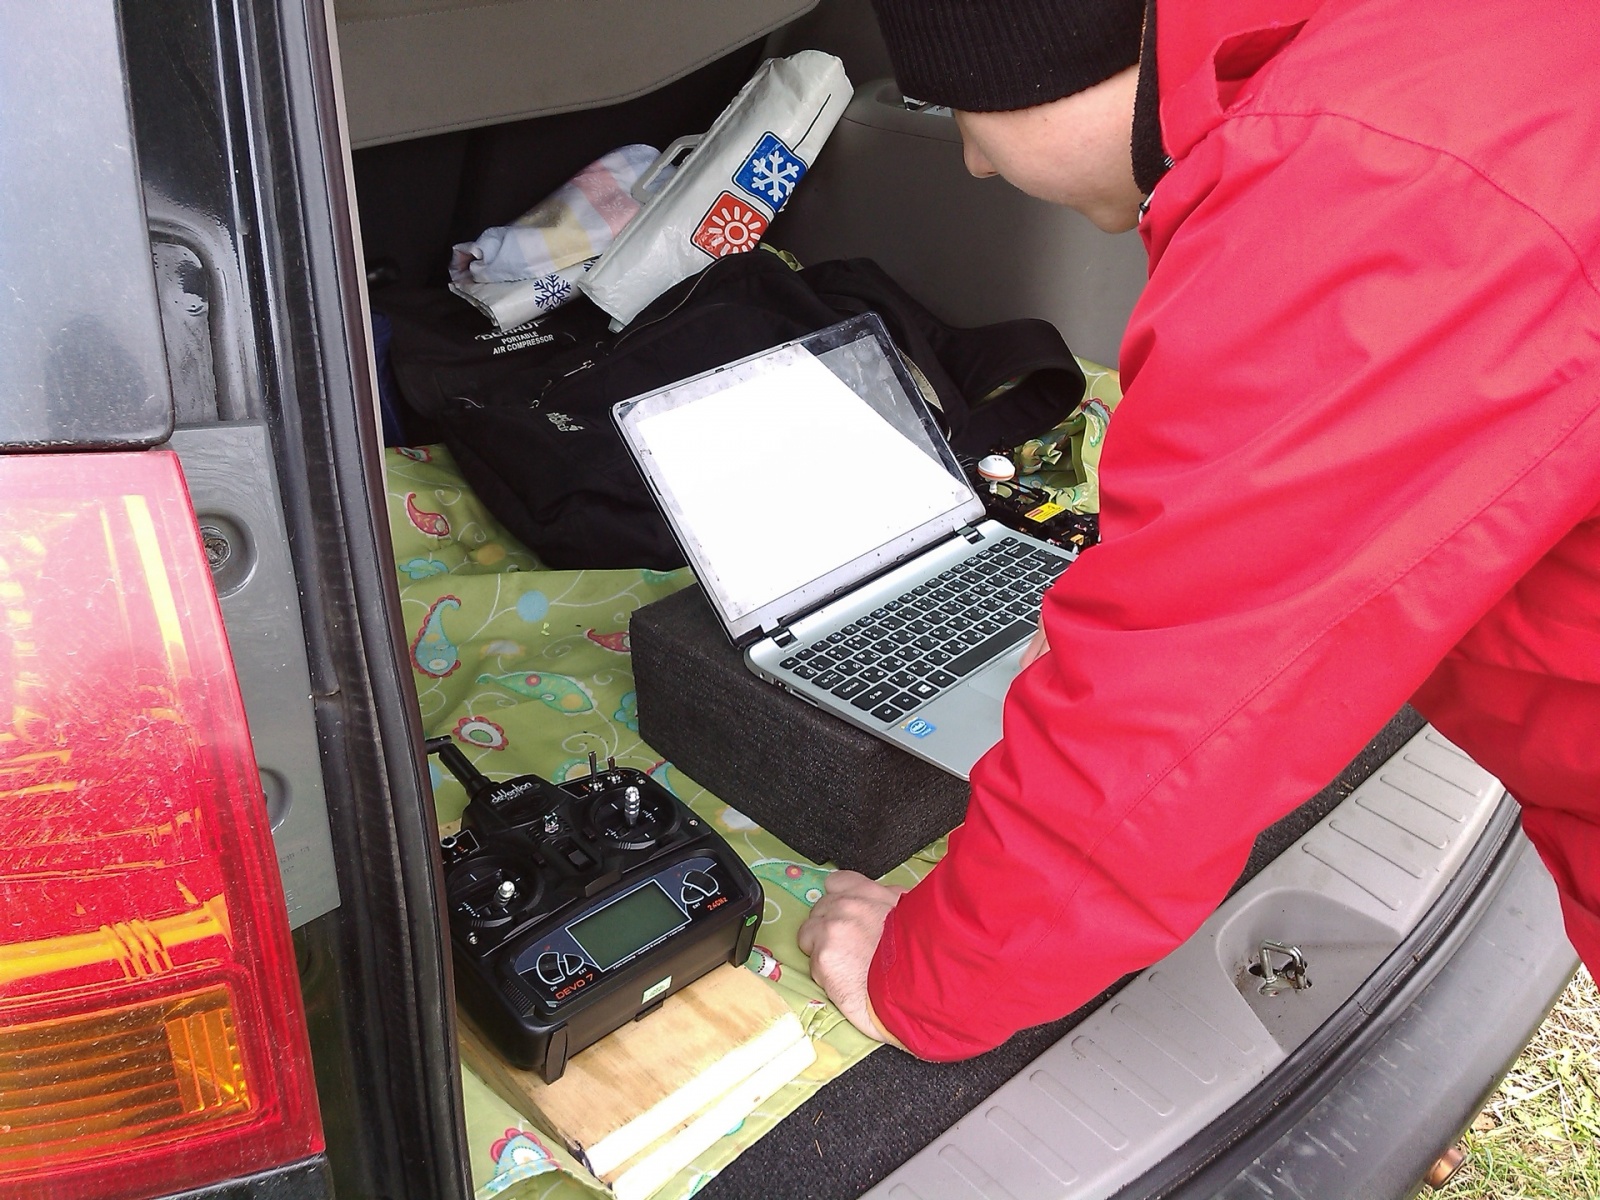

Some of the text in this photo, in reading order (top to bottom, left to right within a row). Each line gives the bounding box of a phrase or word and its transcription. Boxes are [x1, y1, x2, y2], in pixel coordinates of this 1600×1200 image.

[493, 334, 554, 355] AIR COMPRESSOR
[501, 331, 539, 345] PORTABLE
[555, 973, 594, 1000] DEVO 7
